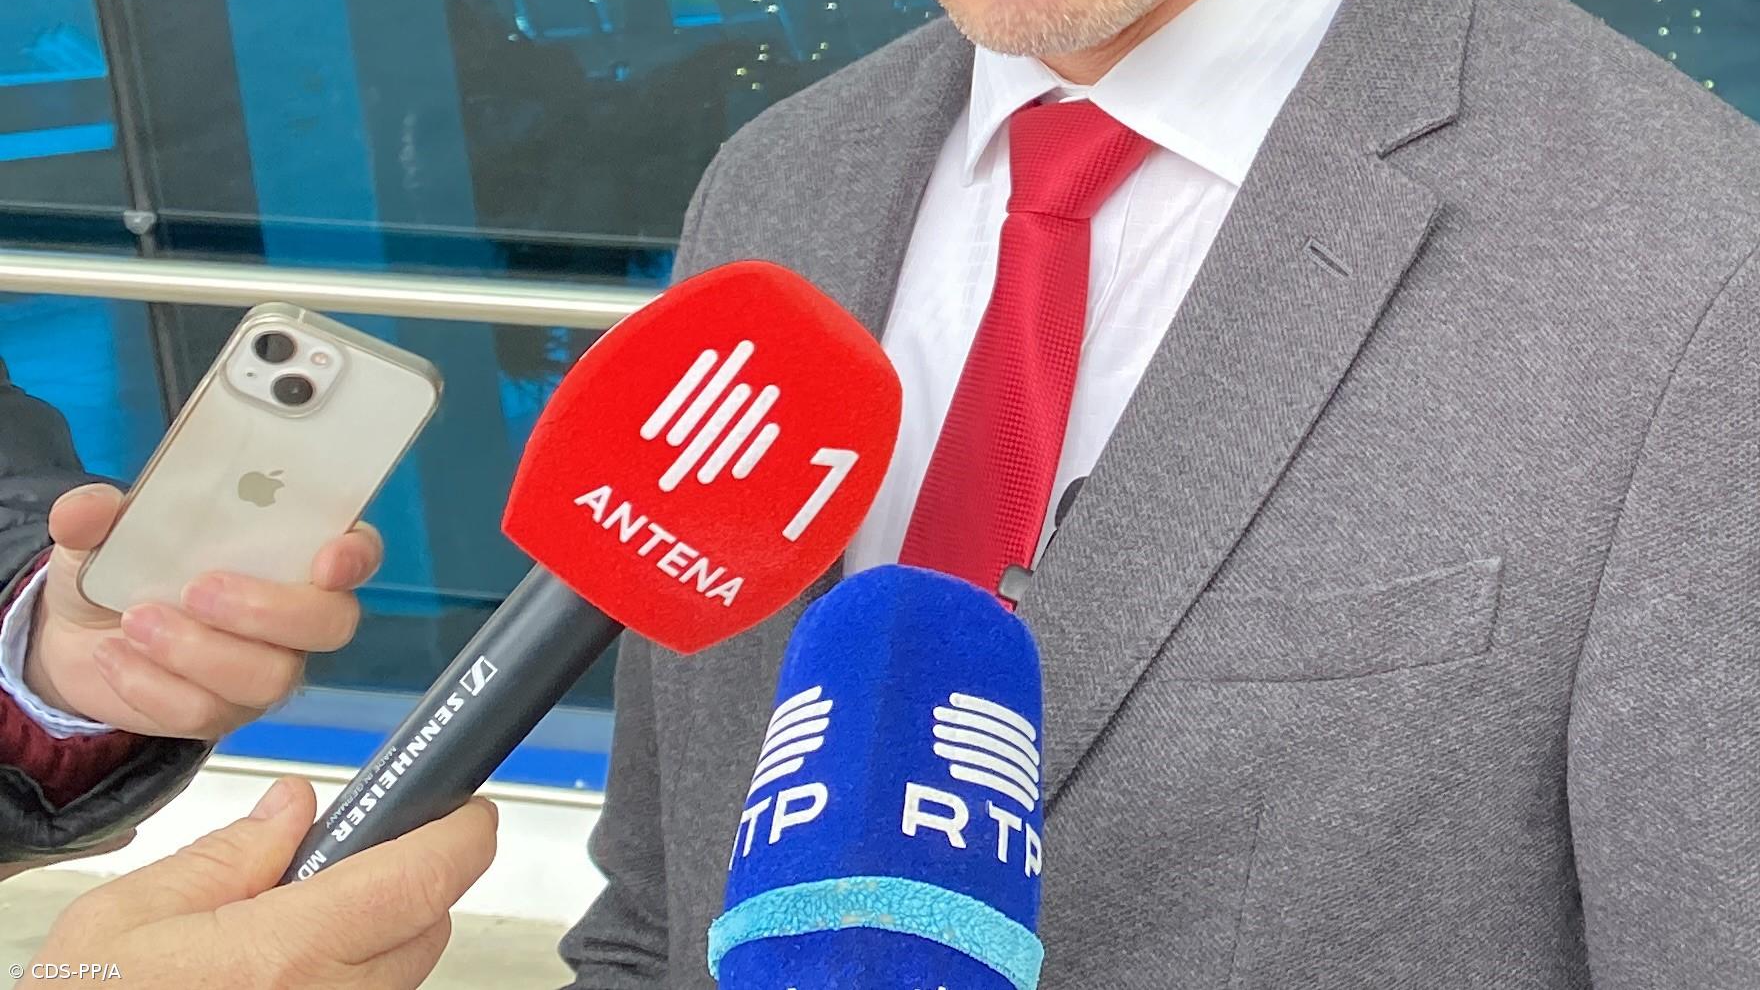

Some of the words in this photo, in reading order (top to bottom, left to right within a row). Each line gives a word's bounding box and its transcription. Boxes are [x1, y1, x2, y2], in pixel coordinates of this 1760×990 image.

[573, 485, 746, 607] ANTENA
[781, 447, 860, 543] 1
[330, 691, 465, 843] SENNHEISER
[297, 849, 327, 881] MD
[728, 781, 829, 871] TP
[901, 781, 1043, 878] RTP
